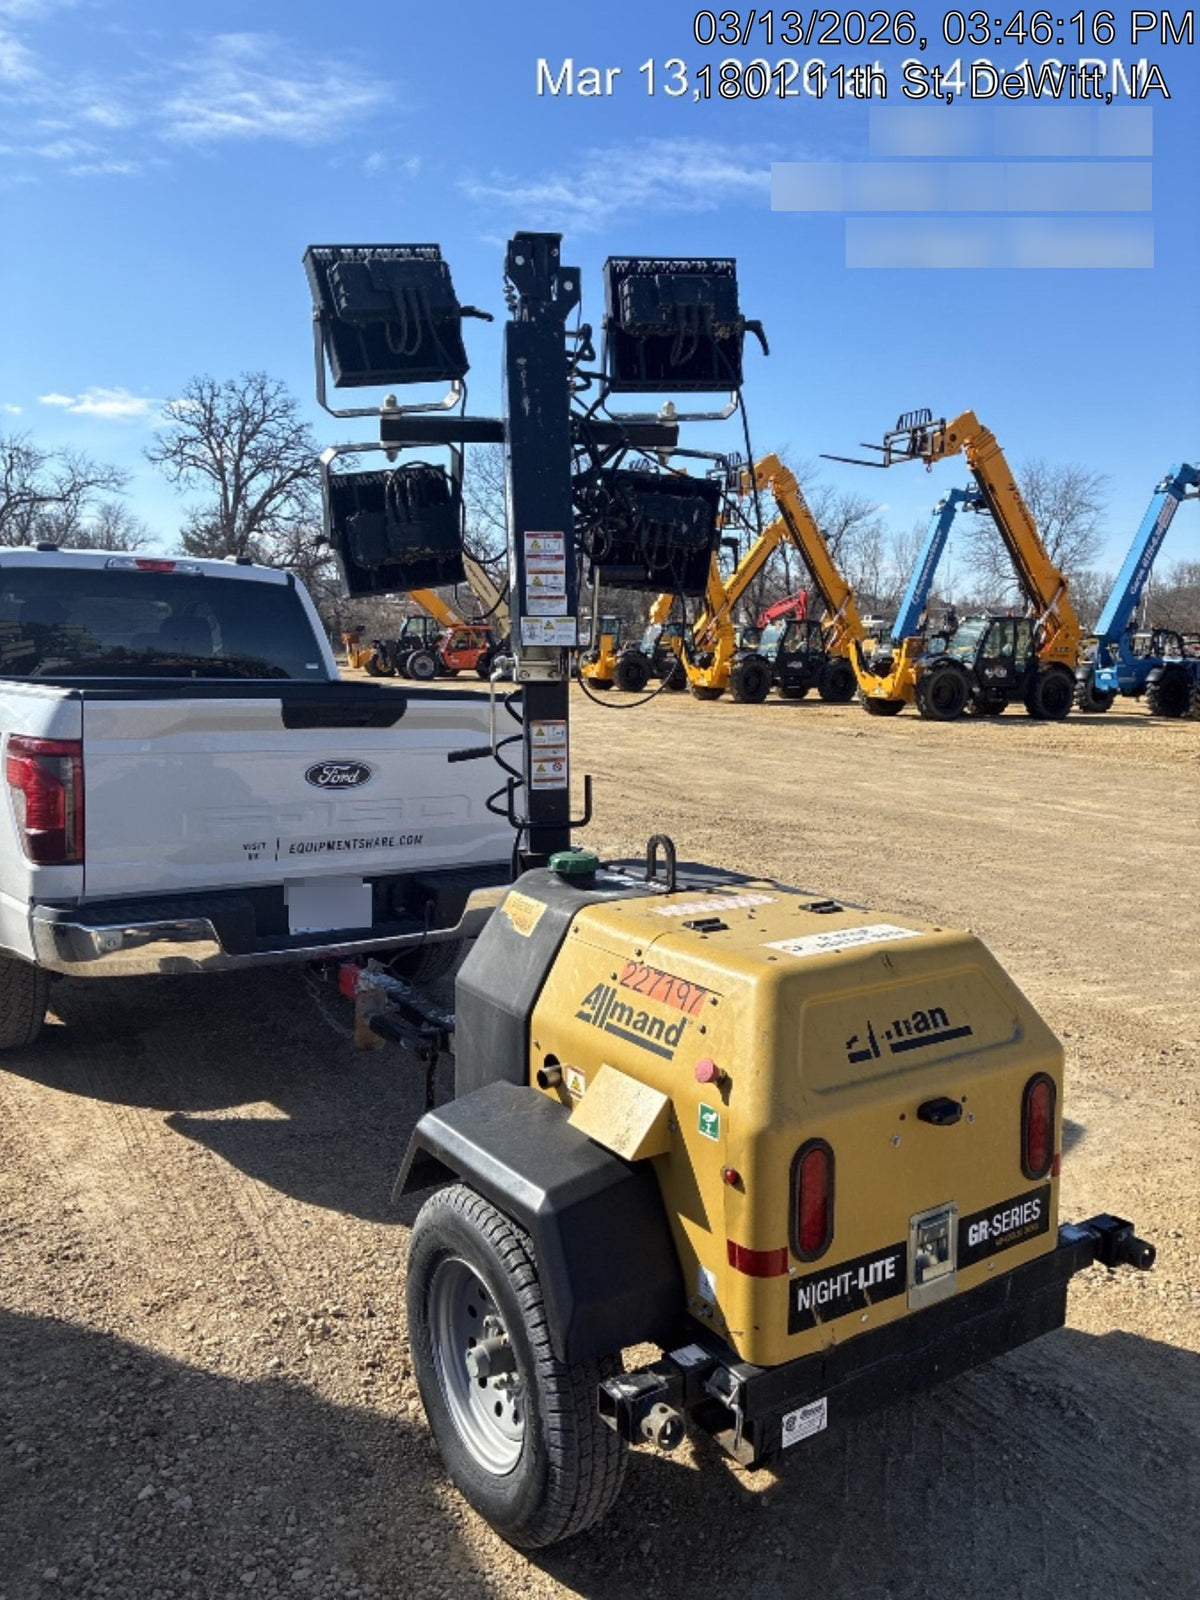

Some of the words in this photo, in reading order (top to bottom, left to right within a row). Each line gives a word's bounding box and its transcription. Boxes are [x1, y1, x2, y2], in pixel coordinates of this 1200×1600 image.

[317, 764, 360, 784] Ford
[288, 834, 424, 855] EQUIPMENTSHARE.COM
[619, 960, 708, 1014] 227197
[579, 982, 689, 1050] Allmand
[967, 1197, 1042, 1248] GR-SERIES
[797, 1257, 896, 1312] NIGHT-LITE
